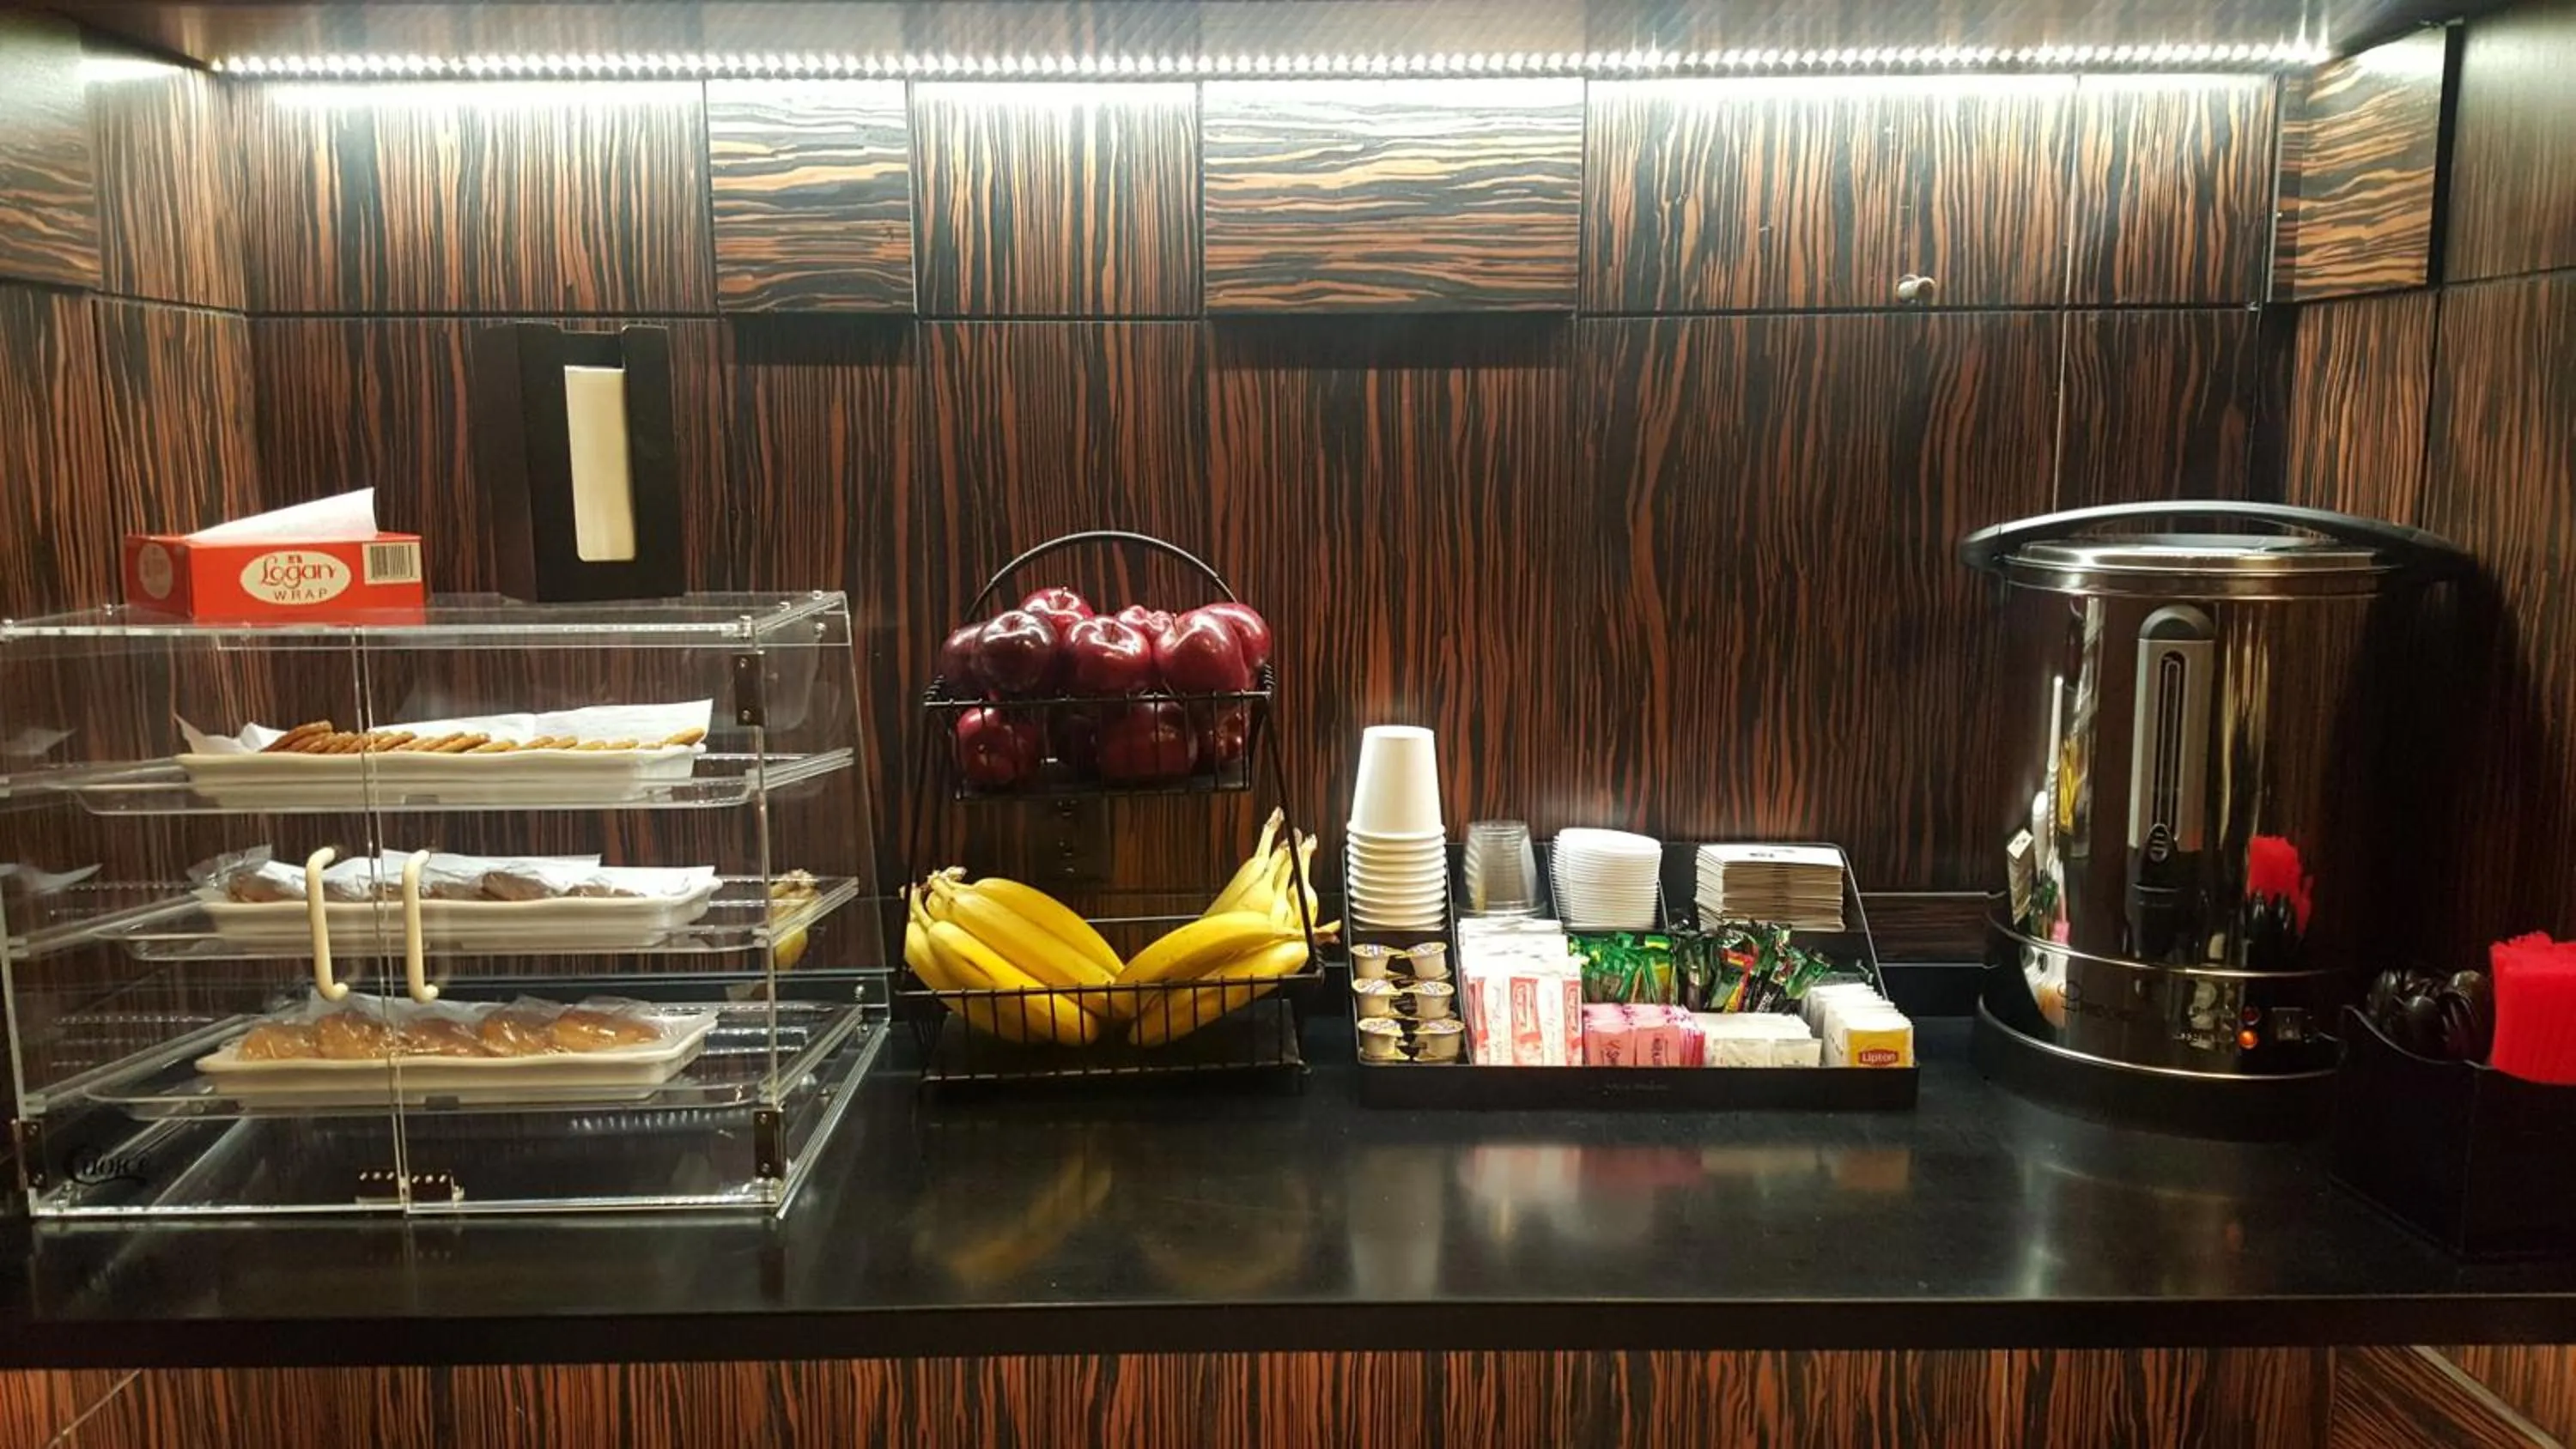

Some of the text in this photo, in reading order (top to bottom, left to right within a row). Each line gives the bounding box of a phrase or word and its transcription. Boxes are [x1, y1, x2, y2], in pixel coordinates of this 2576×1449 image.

[261, 555, 335, 590] Logan
[274, 588, 328, 600] WRAP
[1862, 1052, 1896, 1064] Lipton
